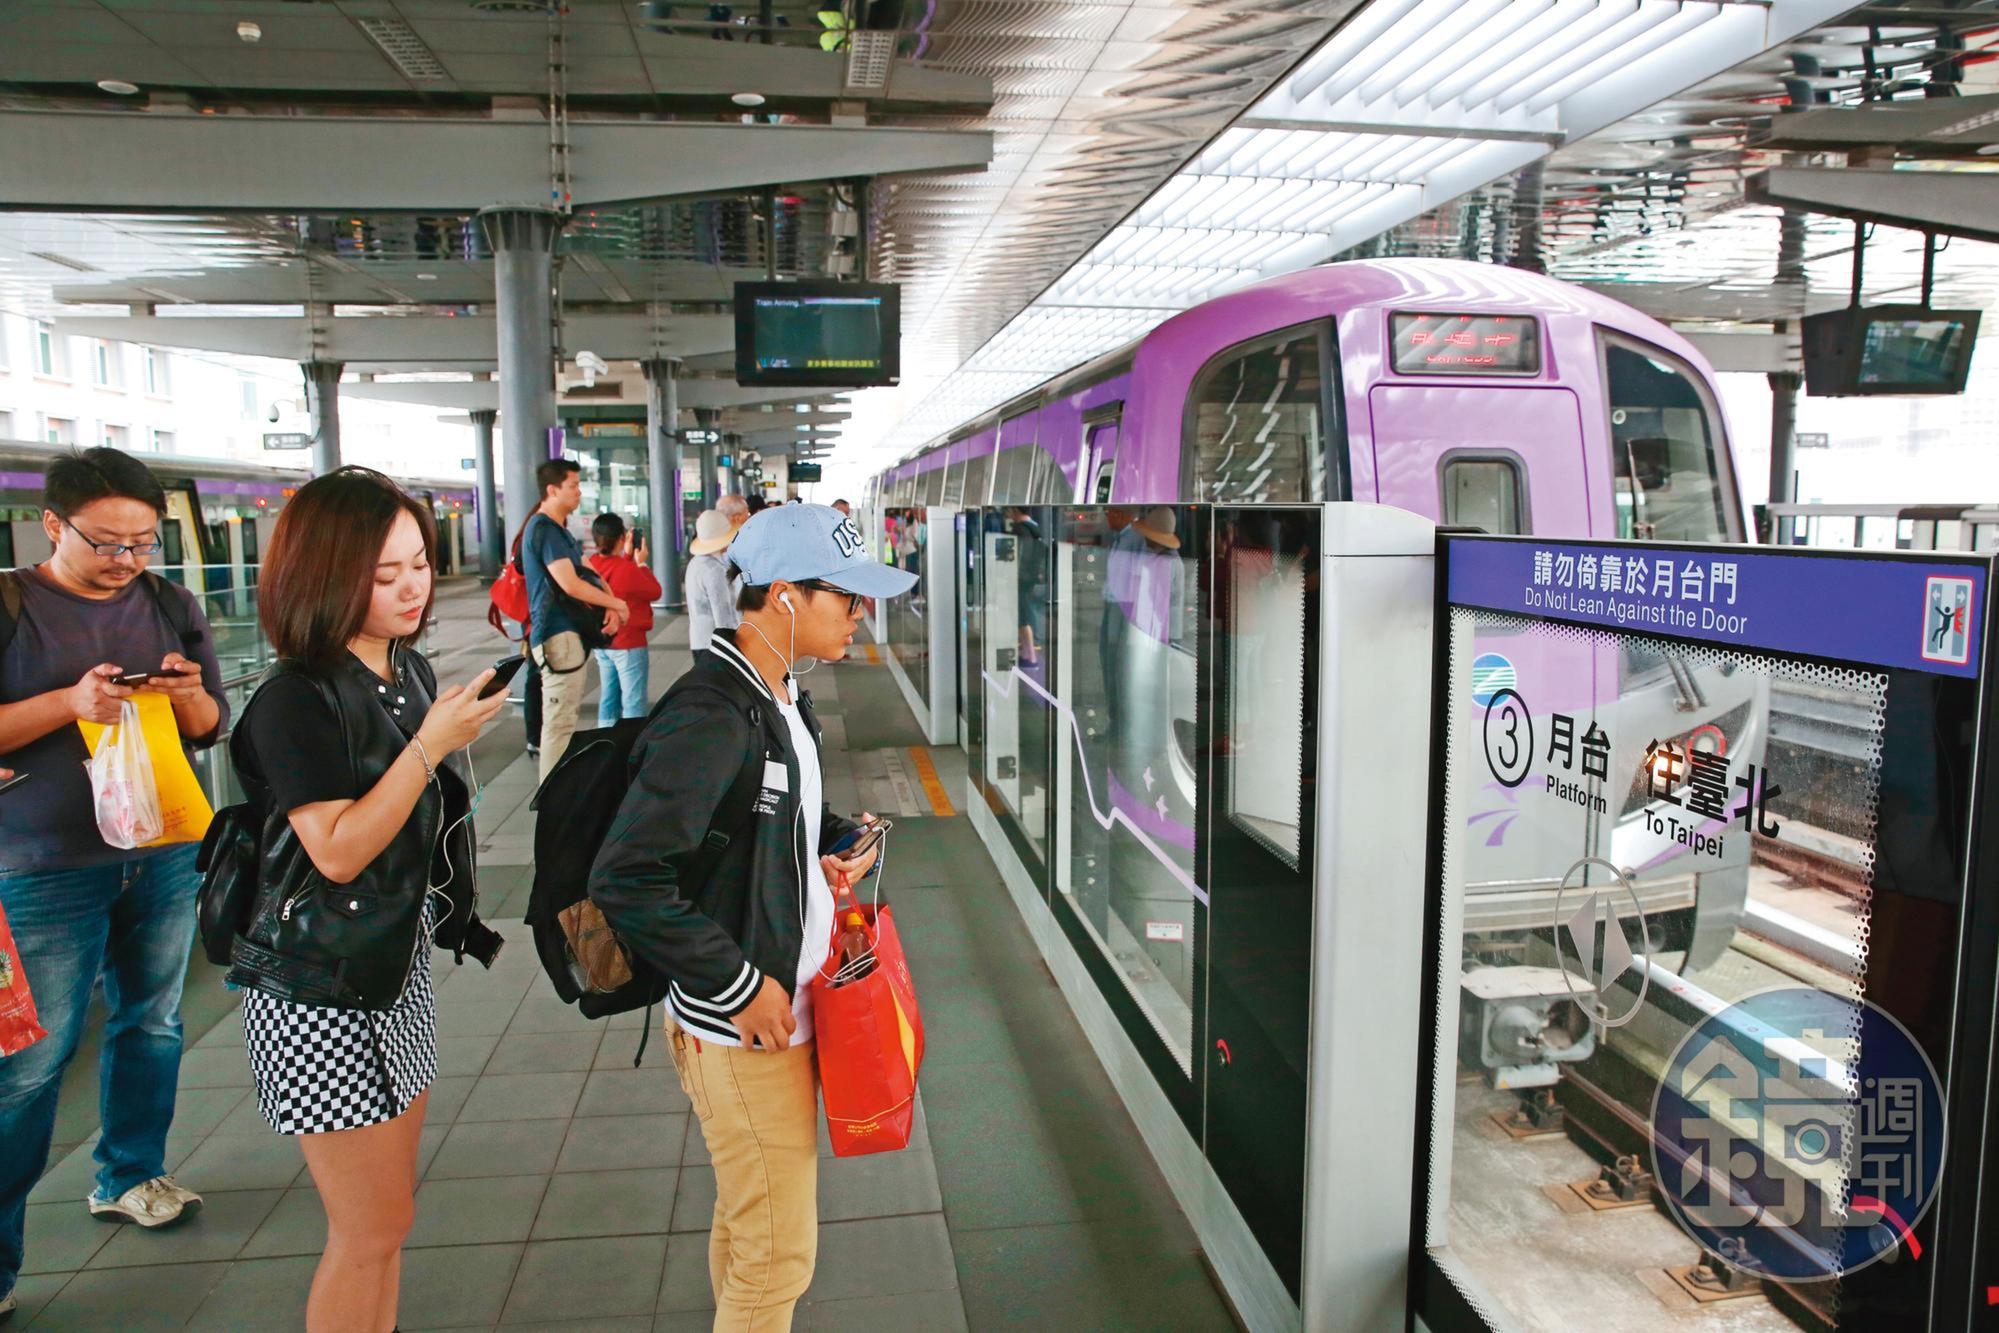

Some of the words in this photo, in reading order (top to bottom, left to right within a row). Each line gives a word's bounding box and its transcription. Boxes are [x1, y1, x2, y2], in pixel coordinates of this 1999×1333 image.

[1534, 551, 1738, 605] 請勿倚靠於月台門
[1525, 587, 1542, 607] Do
[1545, 589, 1567, 611] Not
[1570, 592, 1603, 616] Lean
[1606, 597, 1666, 624] Against
[1670, 604, 1697, 628] the
[1702, 607, 1748, 634] Door
[1547, 712, 1612, 783] 月台
[1546, 774, 1607, 815] Platform
[1644, 737, 1782, 839] 往臺北
[1644, 808, 1664, 836] To
[1667, 816, 1724, 859] Taipei
